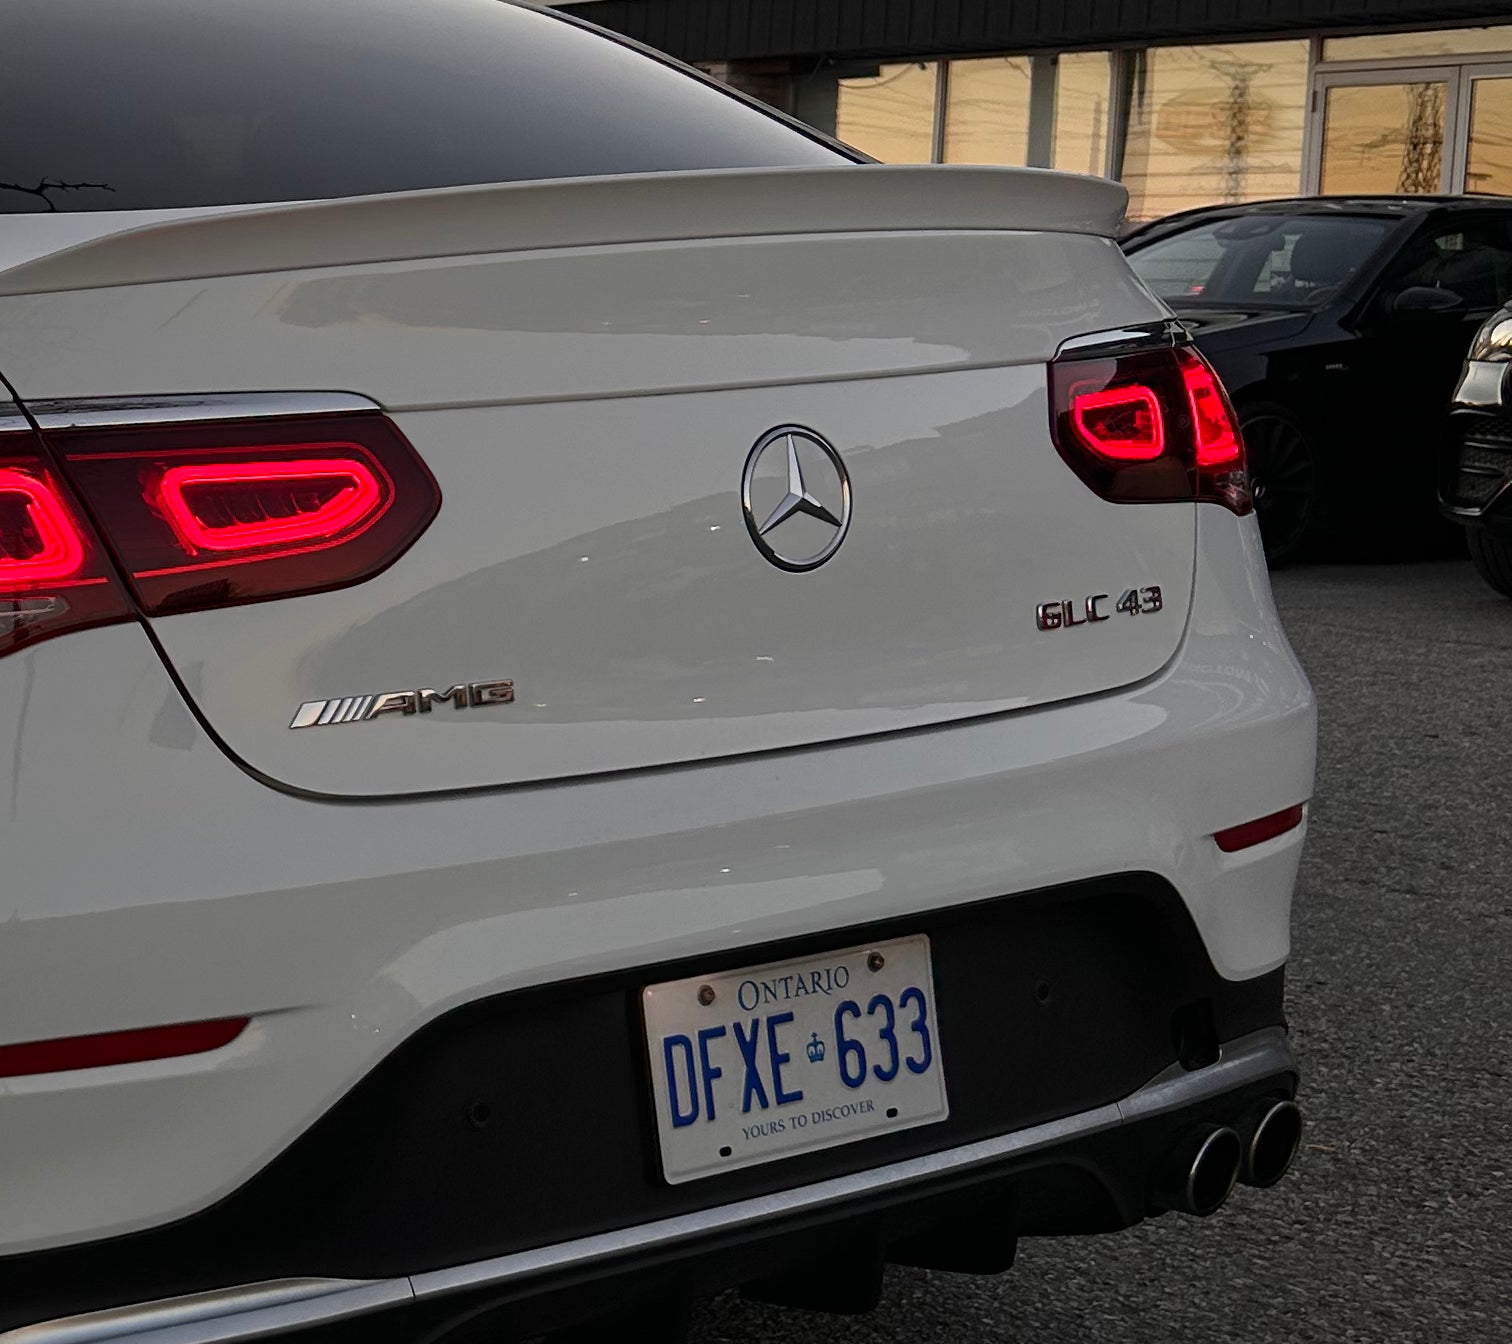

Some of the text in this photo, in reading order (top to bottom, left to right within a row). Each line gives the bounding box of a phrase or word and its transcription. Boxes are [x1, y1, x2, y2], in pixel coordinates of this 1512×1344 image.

[1036, 585, 1163, 631] GLC 43
[738, 965, 850, 1011] ONTARIO
[663, 986, 933, 1129] DFXE 633
[742, 1099, 875, 1140] YOURS TO DISCOVER
